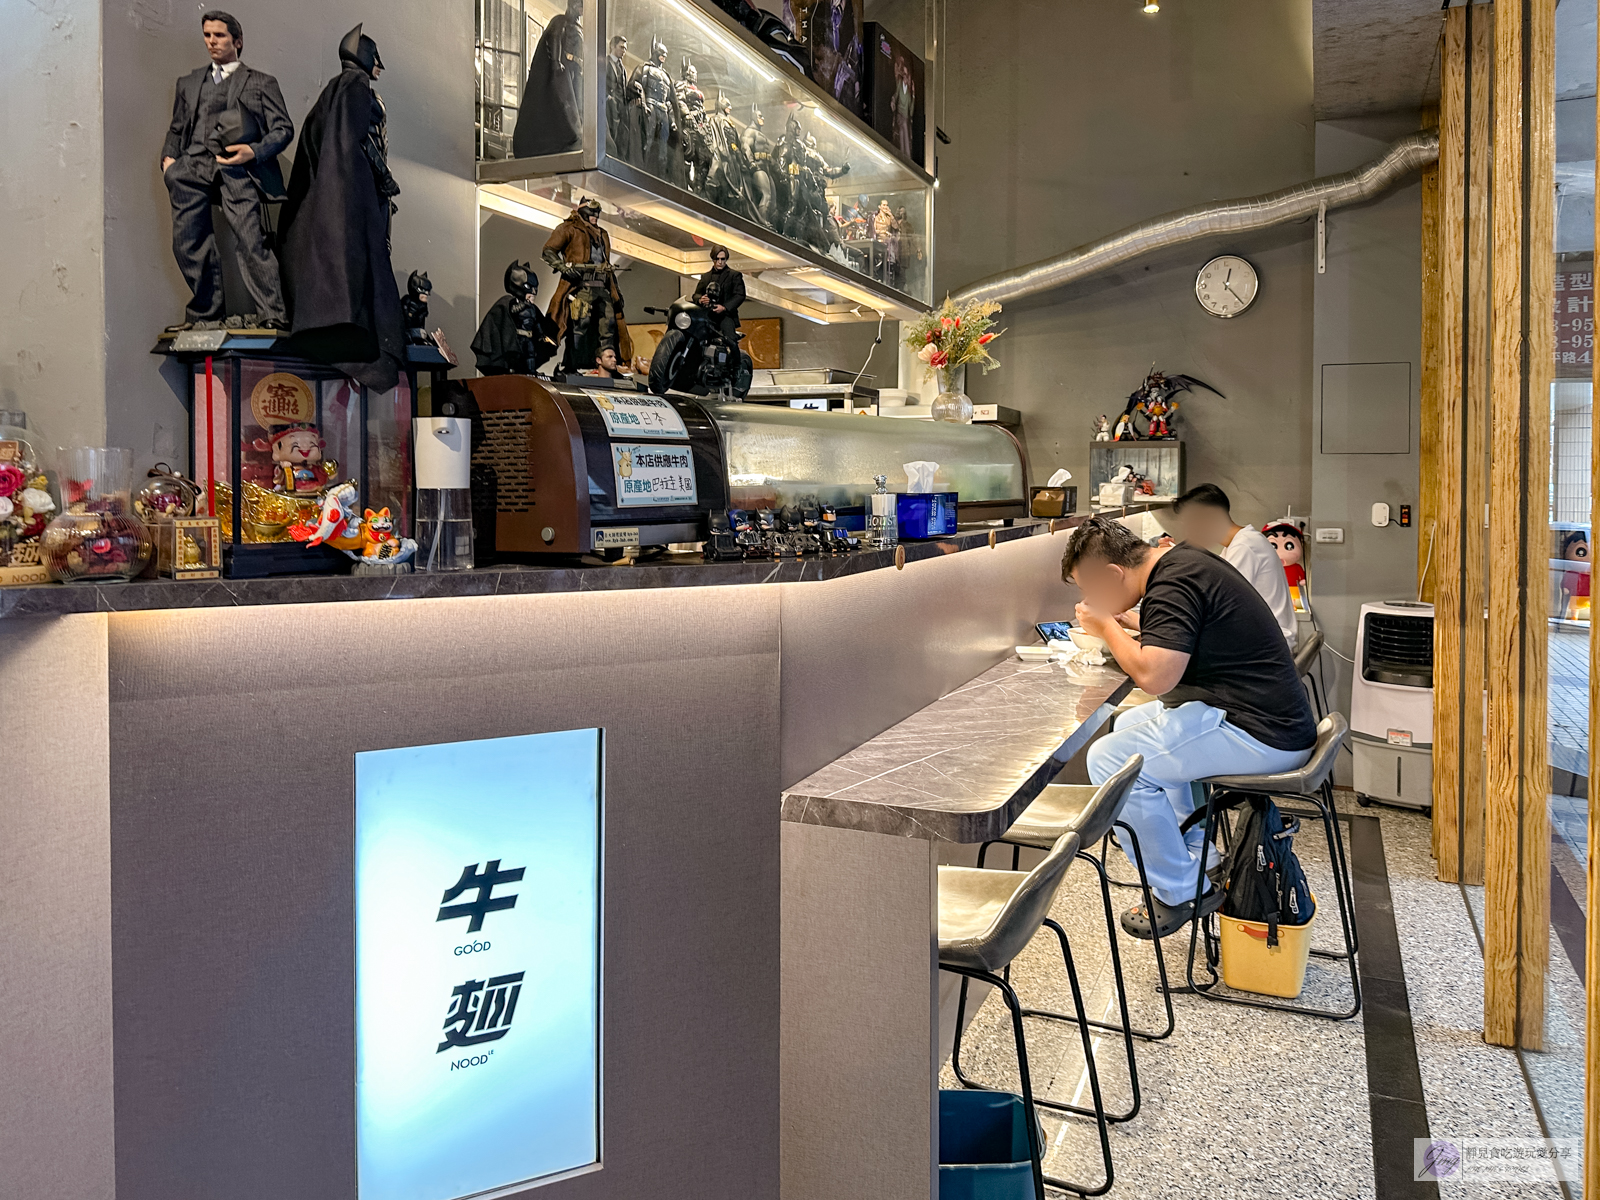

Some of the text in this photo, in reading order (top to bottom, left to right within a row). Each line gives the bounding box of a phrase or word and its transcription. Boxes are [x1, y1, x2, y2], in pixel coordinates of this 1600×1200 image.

[635, 454, 689, 468] 本店供應牛肉
[624, 479, 652, 493] 原產地
[12, 572, 46, 583] NOOD
[435, 858, 527, 934] 牛
